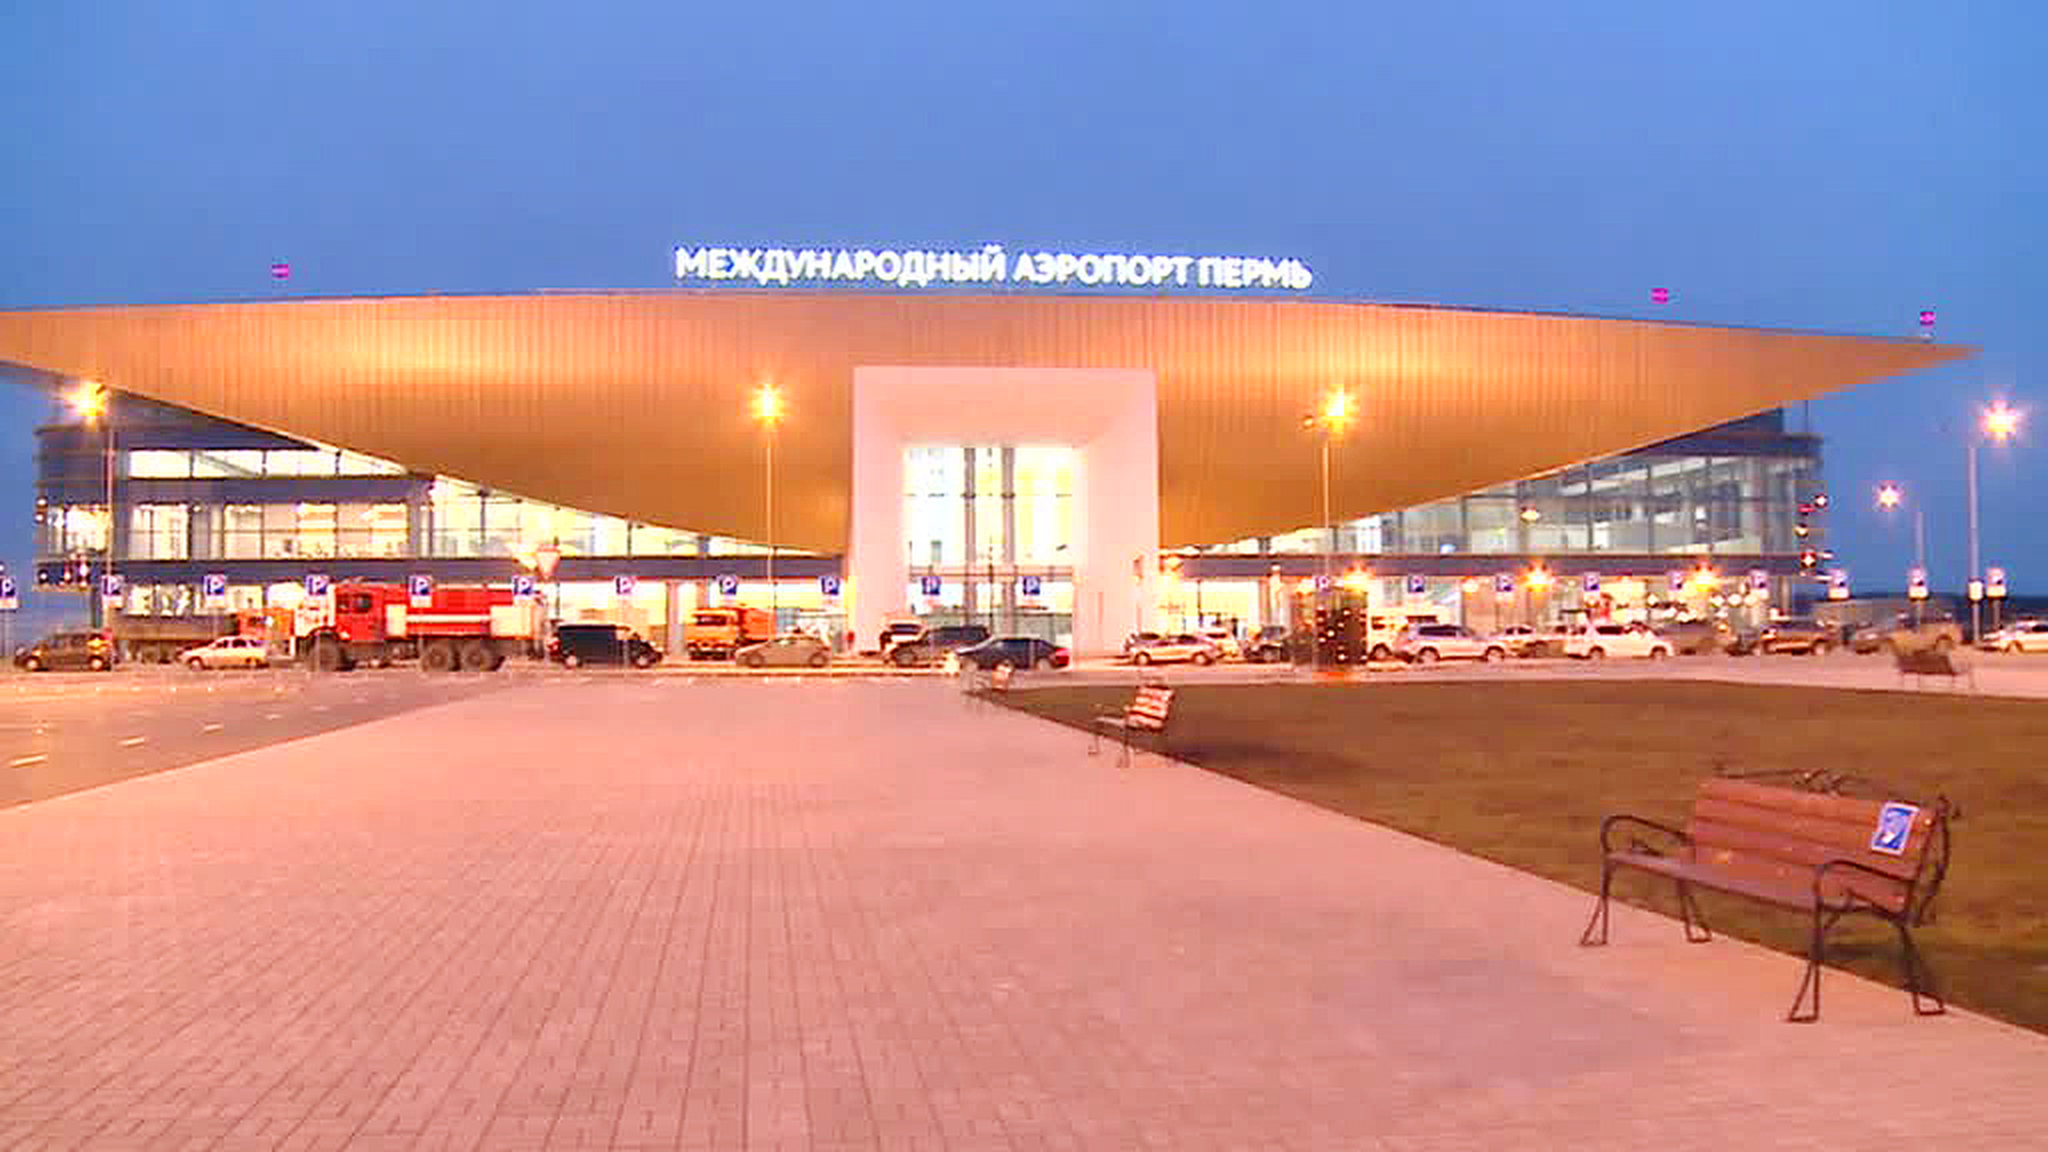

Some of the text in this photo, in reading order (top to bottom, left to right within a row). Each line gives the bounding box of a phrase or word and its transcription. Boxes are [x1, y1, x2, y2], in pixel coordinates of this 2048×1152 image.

[675, 244, 1313, 290] МЕЖДУНАРОДНЫЙ АЭРОПОРТ ПЕРМЬ
